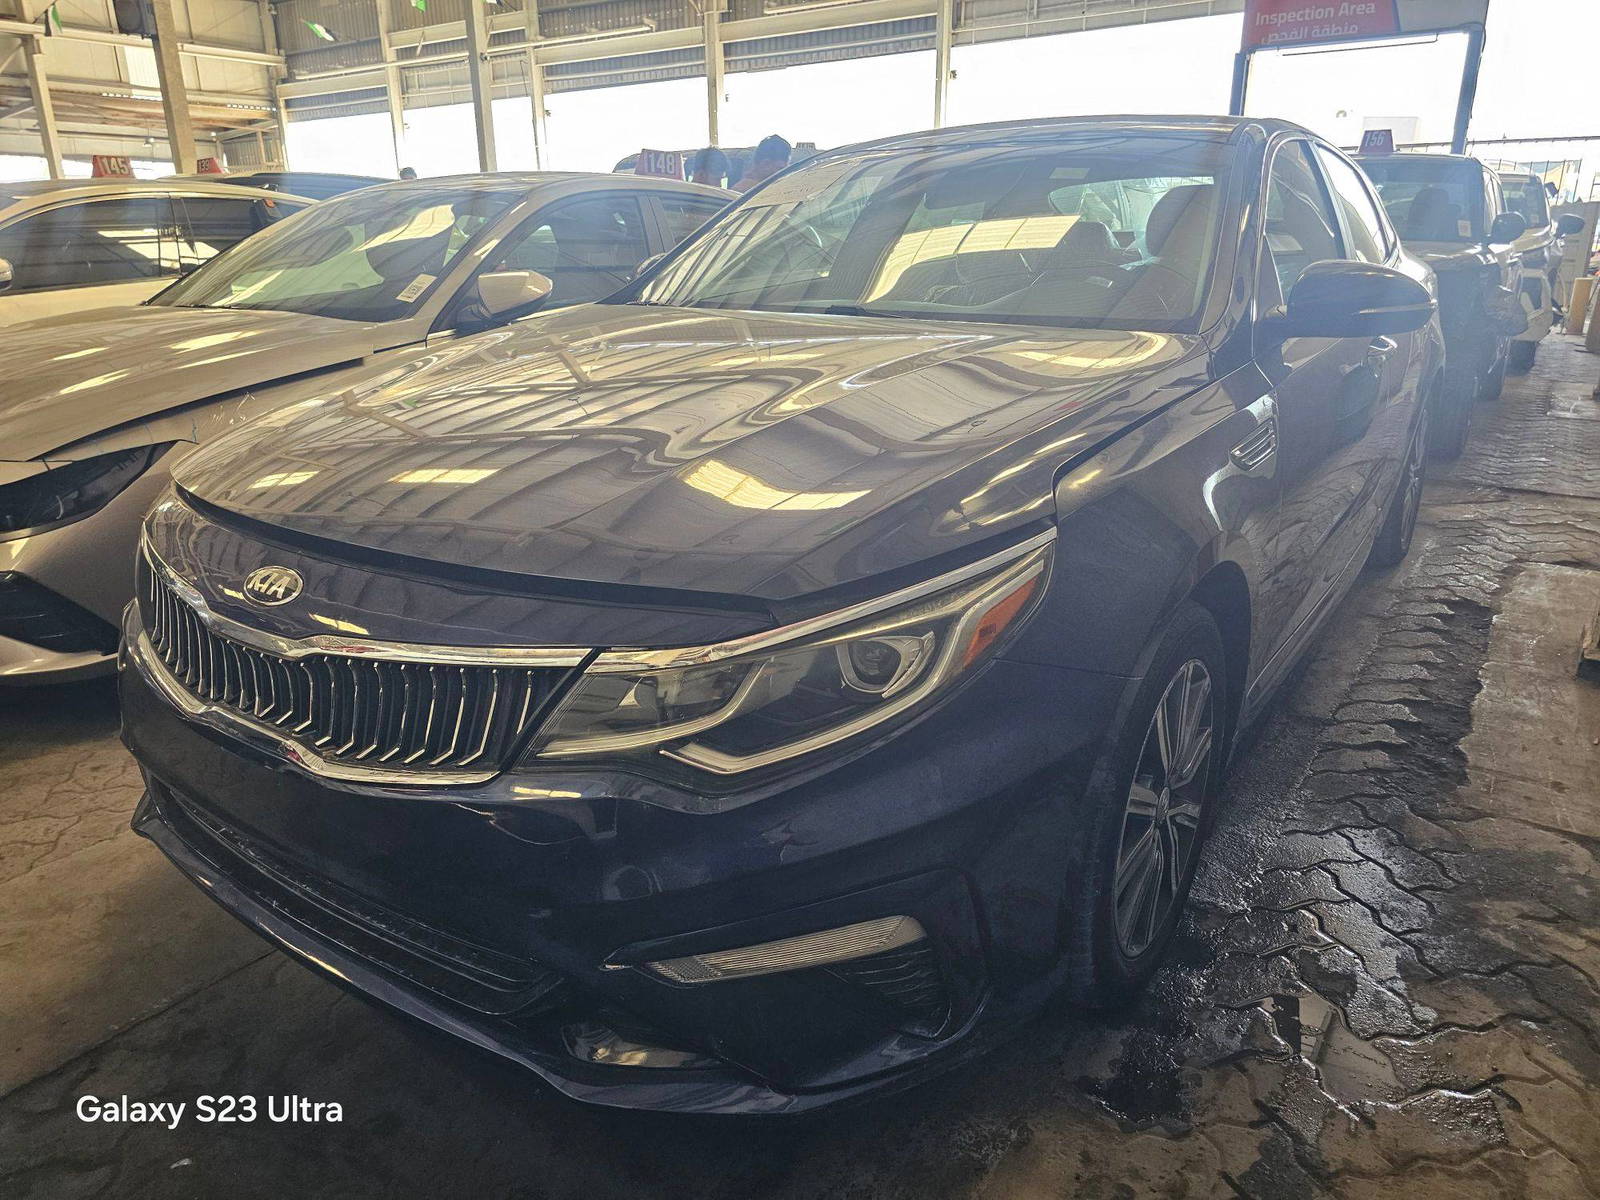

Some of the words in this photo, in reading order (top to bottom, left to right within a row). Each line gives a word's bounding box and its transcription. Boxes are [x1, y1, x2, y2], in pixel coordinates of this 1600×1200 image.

[1255, 5, 1334, 27] Inspection
[1338, 2, 1376, 17] Area
[1311, 22, 1359, 38] منطقة
[1364, 131, 1386, 147] 156
[246, 569, 292, 600] KIA
